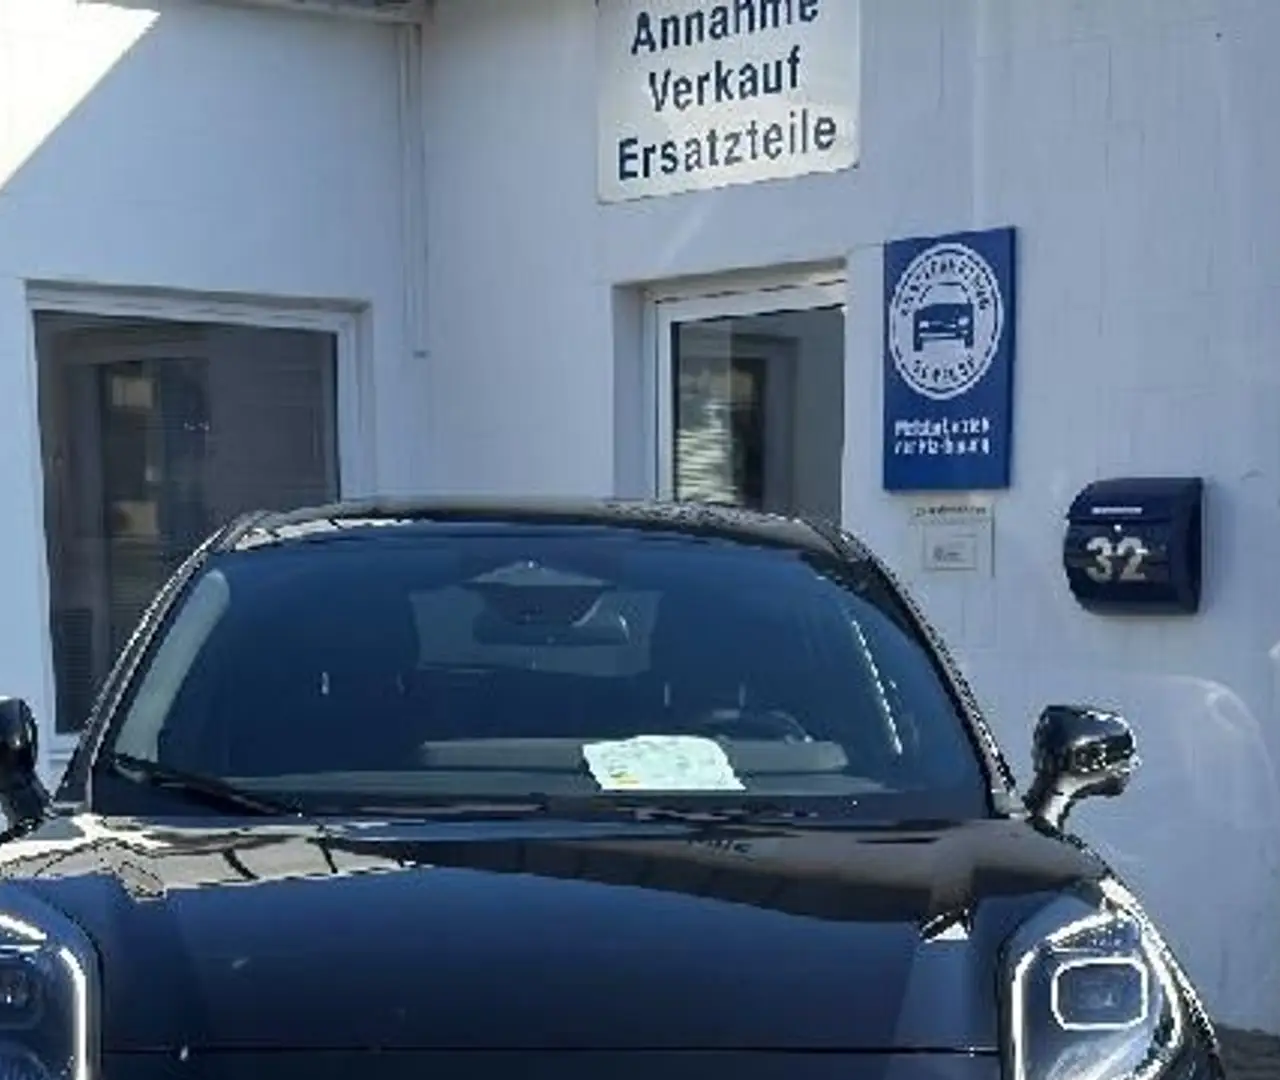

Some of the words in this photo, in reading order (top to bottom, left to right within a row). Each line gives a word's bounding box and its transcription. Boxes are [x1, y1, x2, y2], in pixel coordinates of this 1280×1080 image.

[631, 0, 819, 55] Annahme
[649, 46, 800, 112] Verkauf
[618, 108, 837, 180] Ersatzteile
[1086, 536, 1148, 583] 32
